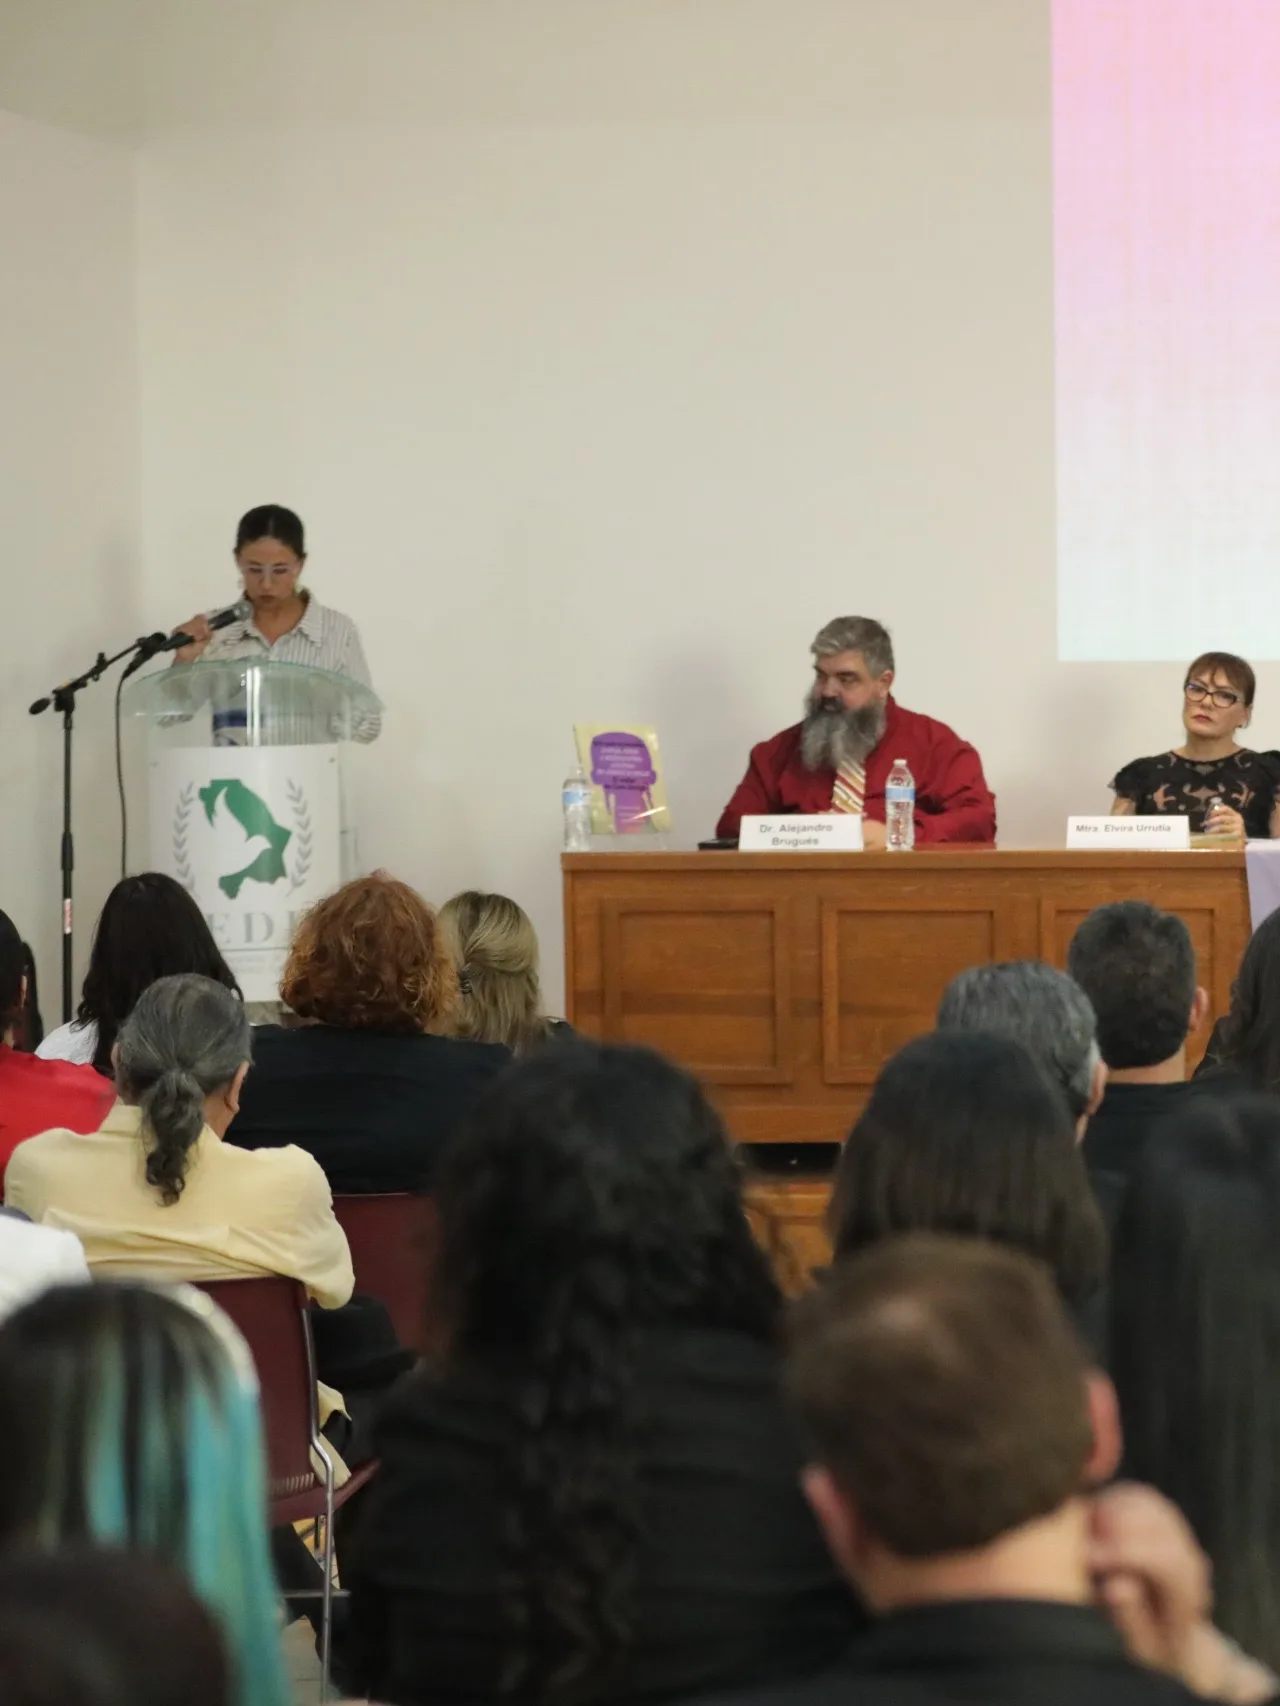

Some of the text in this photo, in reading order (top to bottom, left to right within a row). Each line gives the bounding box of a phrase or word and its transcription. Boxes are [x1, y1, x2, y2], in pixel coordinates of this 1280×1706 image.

[779, 823, 834, 834] Alejandro
[1104, 823, 1133, 833] Elvira
[1136, 823, 1171, 833] Urrutia
